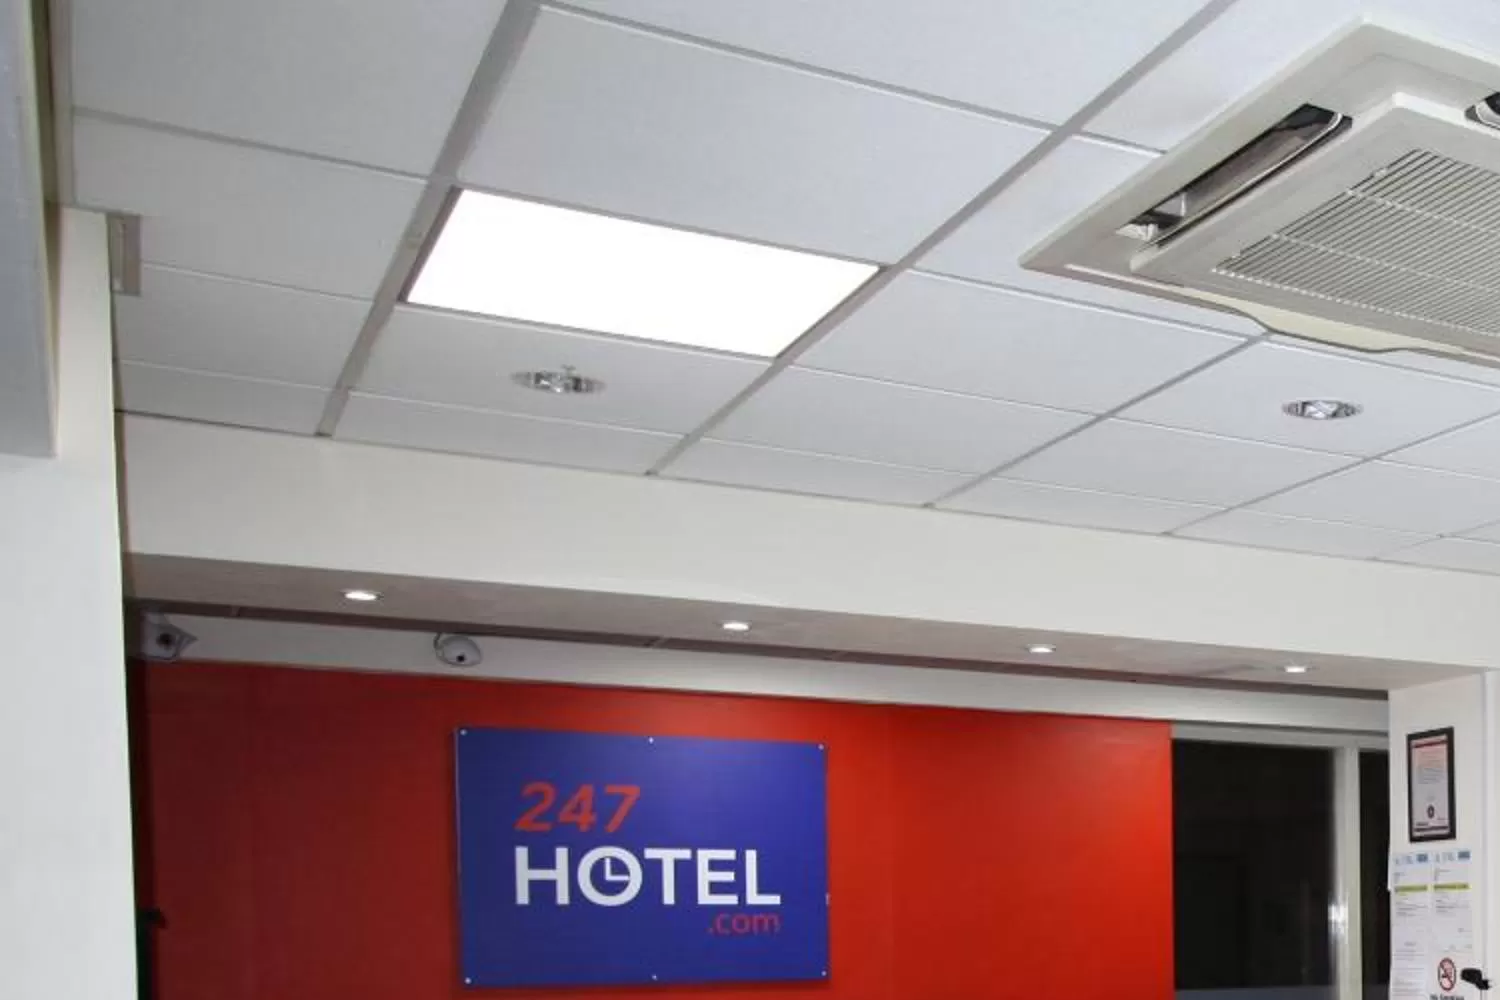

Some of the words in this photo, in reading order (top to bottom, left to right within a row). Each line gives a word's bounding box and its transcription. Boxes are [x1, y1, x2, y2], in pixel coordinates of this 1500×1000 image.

[514, 781, 640, 833] 247
[515, 845, 781, 907] HOTEL
[707, 911, 781, 935] .com
